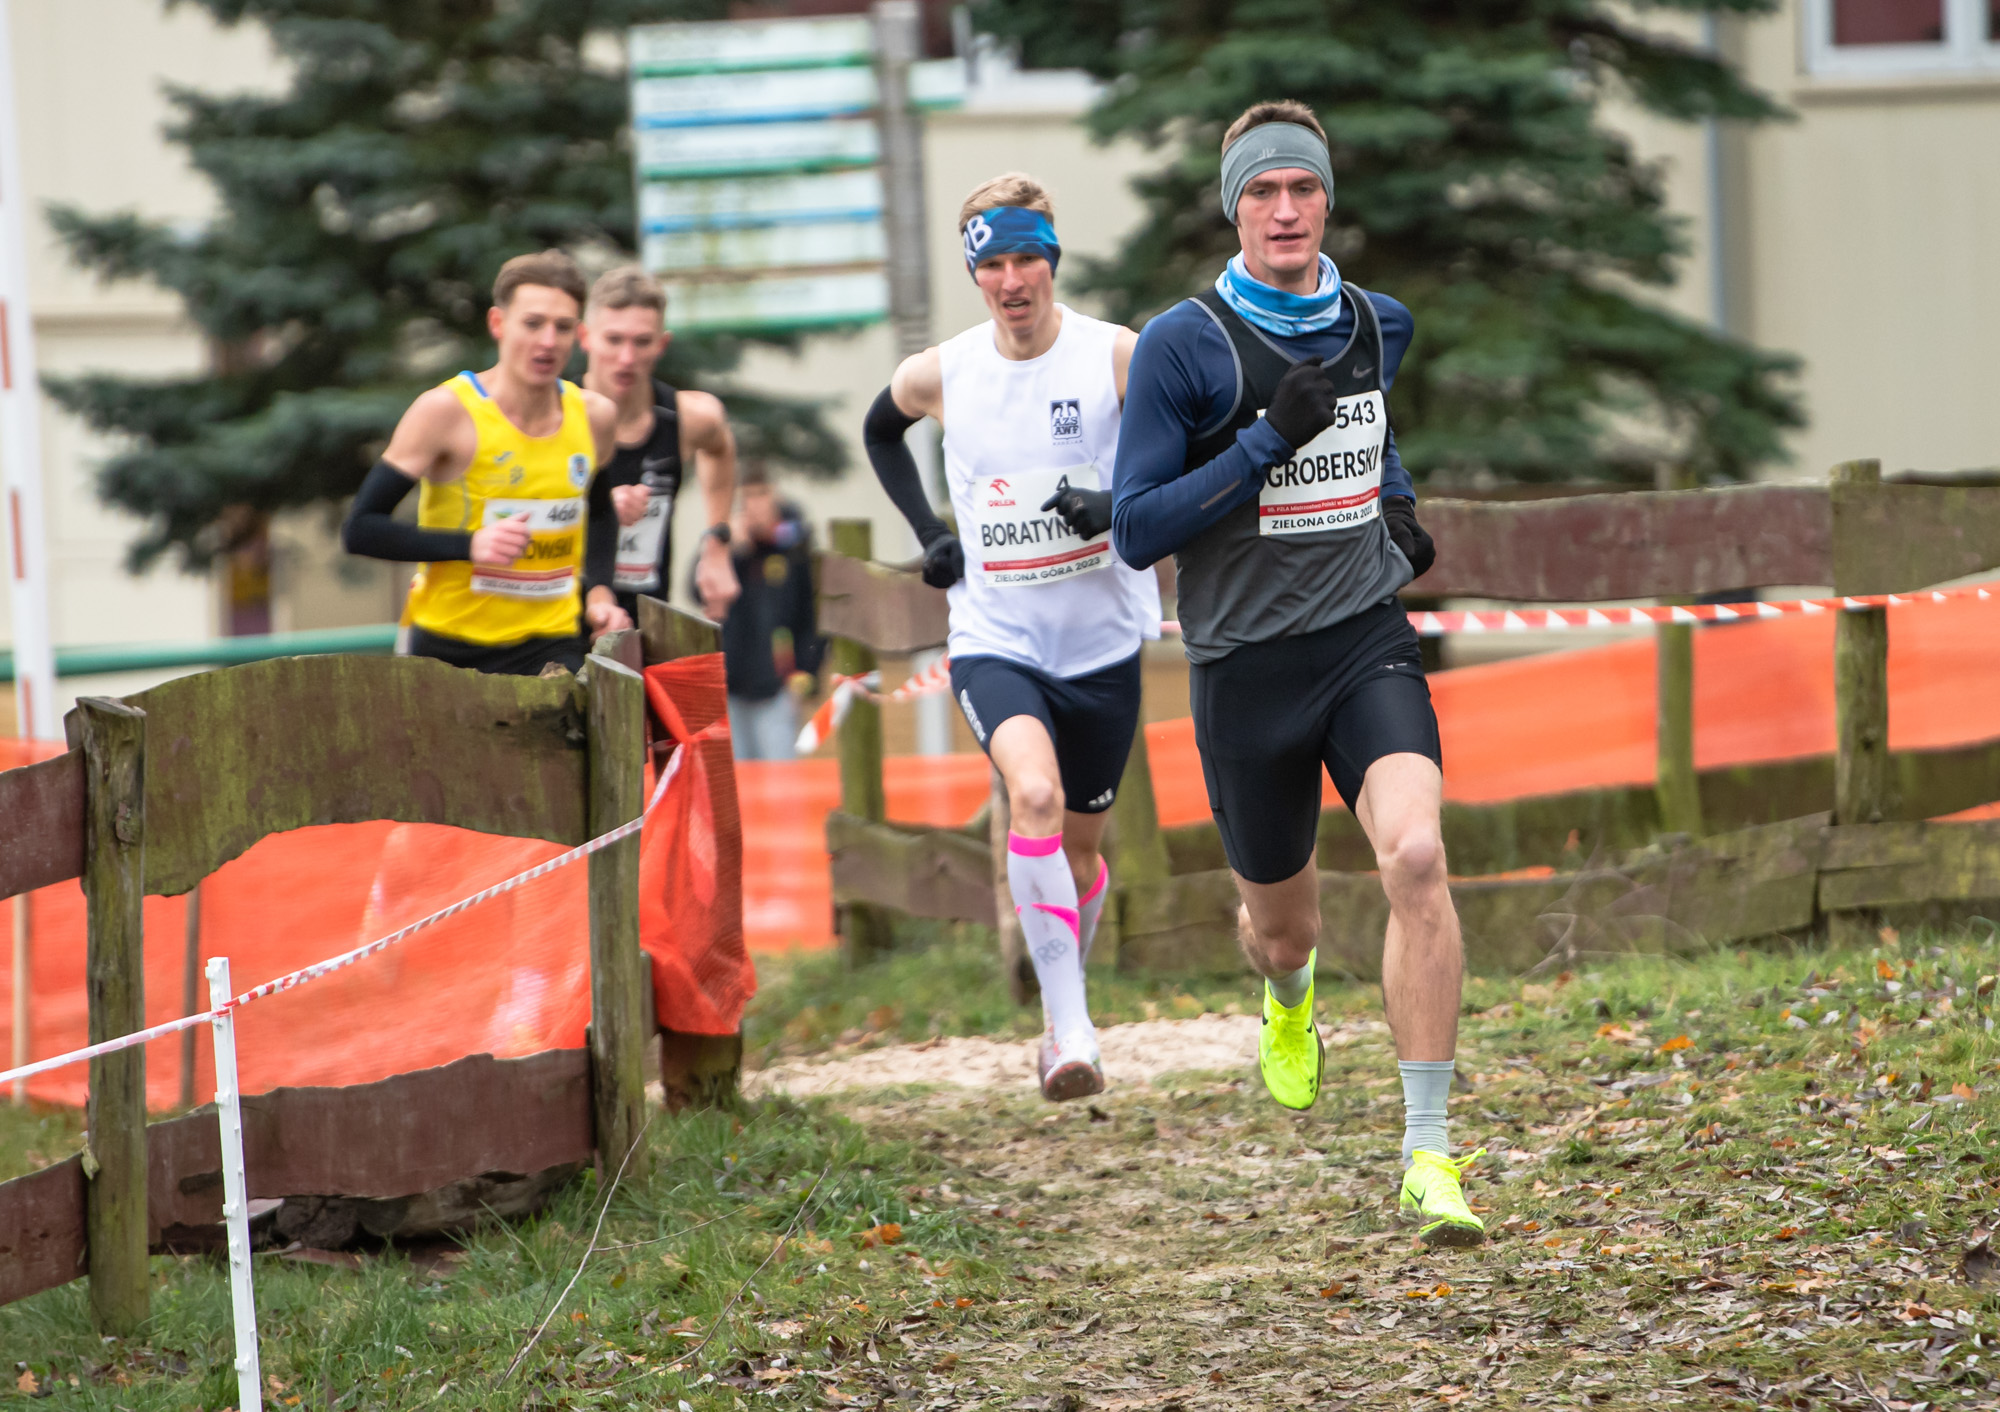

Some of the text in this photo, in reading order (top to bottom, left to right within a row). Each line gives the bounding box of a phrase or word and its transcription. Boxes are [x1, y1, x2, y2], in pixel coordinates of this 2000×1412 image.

[1053, 417, 1078, 427] AZS
[1336, 400, 1376, 429] 543
[1054, 426, 1079, 436] AWF
[1267, 444, 1379, 488] GROBERSKI
[547, 502, 578, 522] 466
[987, 499, 1016, 508] ORLEN
[1272, 504, 1373, 529] ZIELONA GÓRA 2023
[981, 516, 1072, 547] BORATYN
[523, 537, 573, 560] OWSKI
[994, 573, 1039, 583] ZIELONA
[1040, 567, 1074, 579] GÓRA
[1074, 556, 1101, 571] 2023
[1034, 938, 1068, 966] RB
